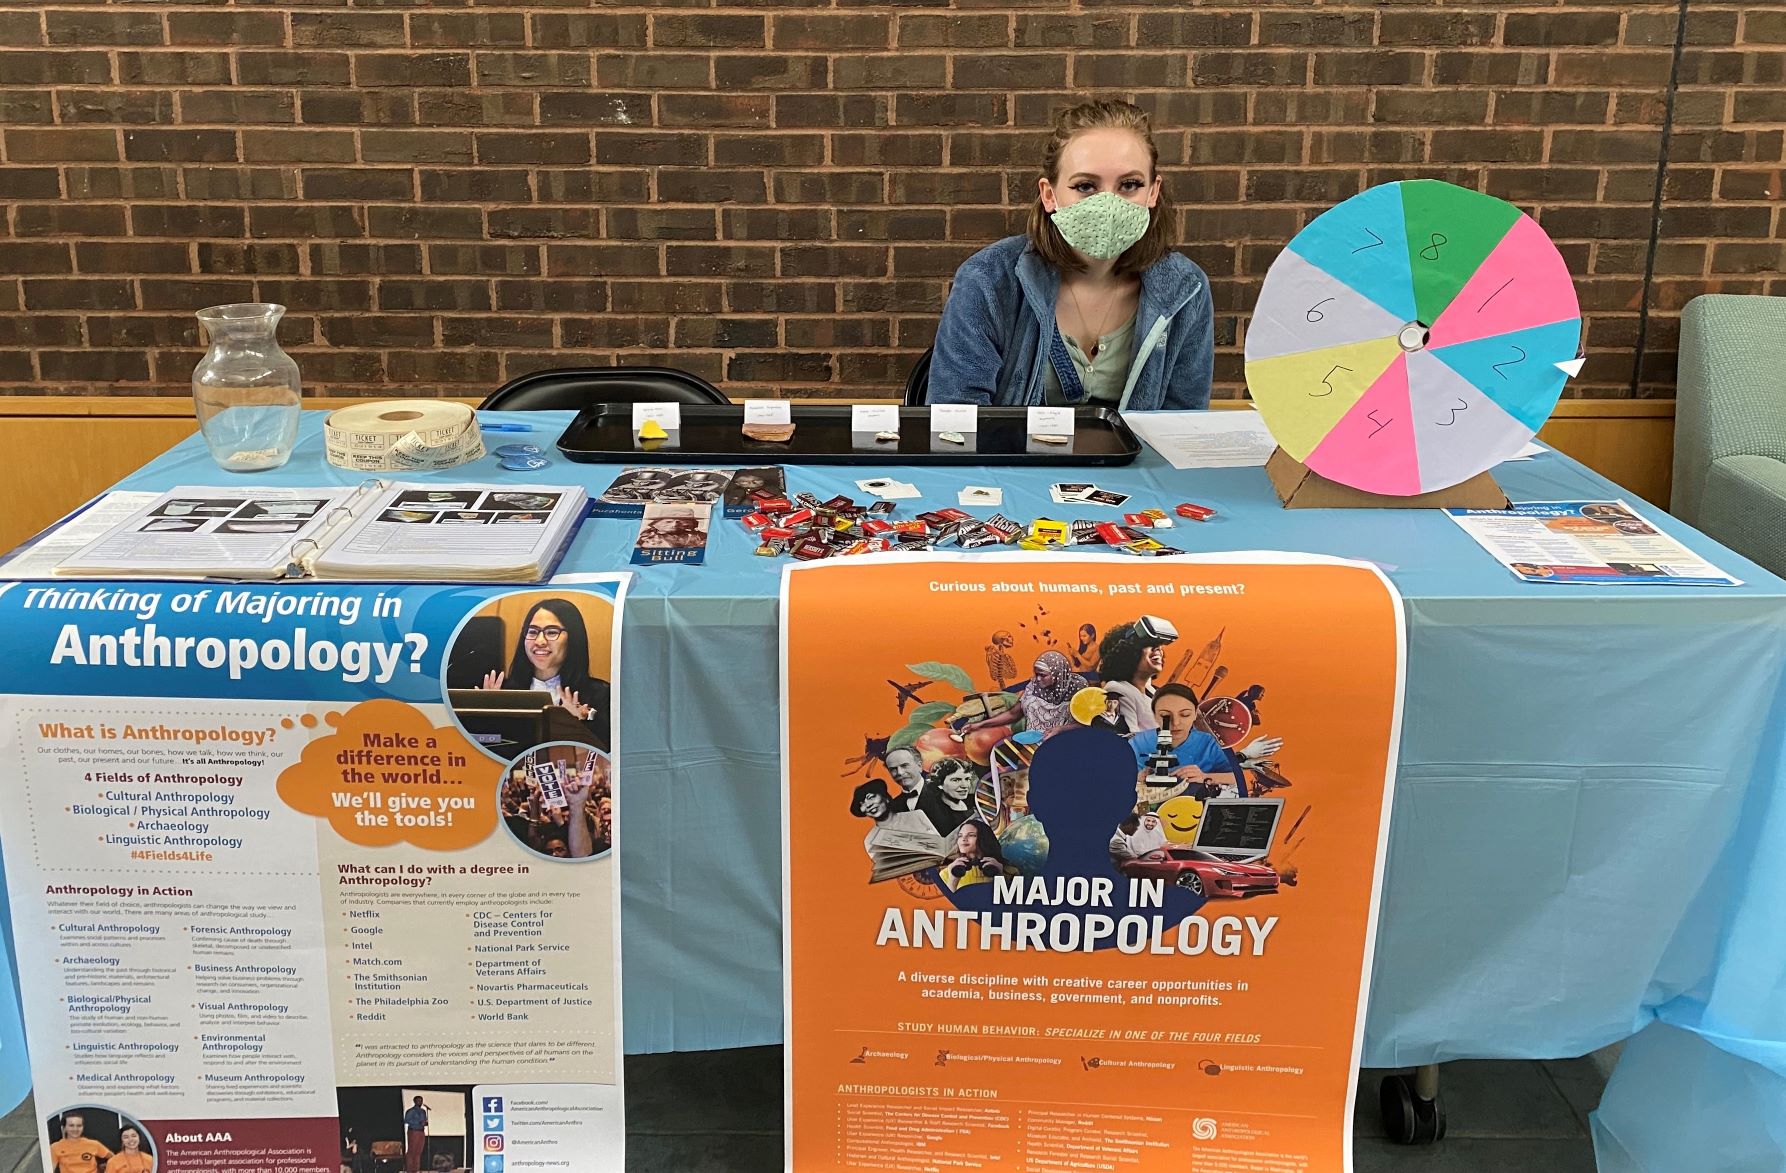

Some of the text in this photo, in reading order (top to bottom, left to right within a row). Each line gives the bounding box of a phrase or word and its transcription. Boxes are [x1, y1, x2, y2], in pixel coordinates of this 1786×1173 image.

[1352, 228, 1383, 254] 7
[1420, 234, 1447, 260] 8
[1478, 278, 1514, 313] 1
[1307, 298, 1335, 322] 6
[1492, 346, 1526, 380] 2
[1309, 365, 1354, 397] 5
[1436, 398, 1468, 426] 3
[1367, 410, 1393, 438] 4
[930, 581, 1244, 596] Curious about humans, past and present?
[24, 588, 402, 625] Thinking of Majoring in
[50, 622, 428, 684] Anthropology?
[40, 724, 276, 746] What is Anthropology?
[361, 733, 436, 750] Make a
[337, 750, 466, 768] difference in
[85, 772, 242, 786] 4 Fields of Anthropology
[341, 768, 462, 784] the world...
[106, 791, 234, 805] Cultural Anthropology
[332, 792, 474, 812] We'll give you
[73, 805, 130, 817] Biological
[142, 806, 187, 818] Physical
[191, 807, 270, 820] Anthropology
[355, 812, 452, 826] the tools!
[138, 820, 208, 834] Archaeology
[106, 834, 242, 848] Linguistic Anthropology
[131, 851, 212, 860] #4Fields4Life
[338, 864, 370, 874] What
[399, 865, 403, 874] I
[408, 865, 423, 874] do
[426, 865, 455, 874] with
[471, 865, 514, 876] degree
[518, 864, 529, 873] in
[340, 876, 432, 888] Anthropology?
[46, 884, 192, 897] Anthropology in Action
[994, 876, 1164, 908] MAJOR IN
[98, 924, 160, 934] Anthropology
[230, 927, 291, 936] Anthropology
[351, 926, 383, 935] Google
[877, 908, 1278, 958] ANTHROPOLOGY
[63, 956, 120, 966] Archaeology
[476, 959, 542, 969] Department of
[236, 965, 296, 975] Anthropology
[898, 972, 1248, 993] A diverse discipline with creative career opportunities in
[68, 995, 151, 1006] Biological/Physical
[375, 998, 429, 1006] Philadelphia
[496, 999, 548, 1007] Department
[922, 988, 1222, 1008] academia, business, government, and nonprofits.
[69, 1004, 130, 1014] Anthropology
[228, 1003, 288, 1013] Anthropology
[898, 1022, 1261, 1043] STUDY HUMAN BEHAVIOR: SPECIALIZE IN ONE OF THE FOUR FIELDS
[73, 1042, 179, 1053] Linguistic Anthropology
[203, 1043, 262, 1052] Anthropology
[114, 1074, 174, 1083] Anthropology
[245, 1074, 304, 1083] Anthropology
[838, 1085, 998, 1098] ANTHROPOLOGISTS IN ACTION
[166, 1133, 232, 1142] About AAA
